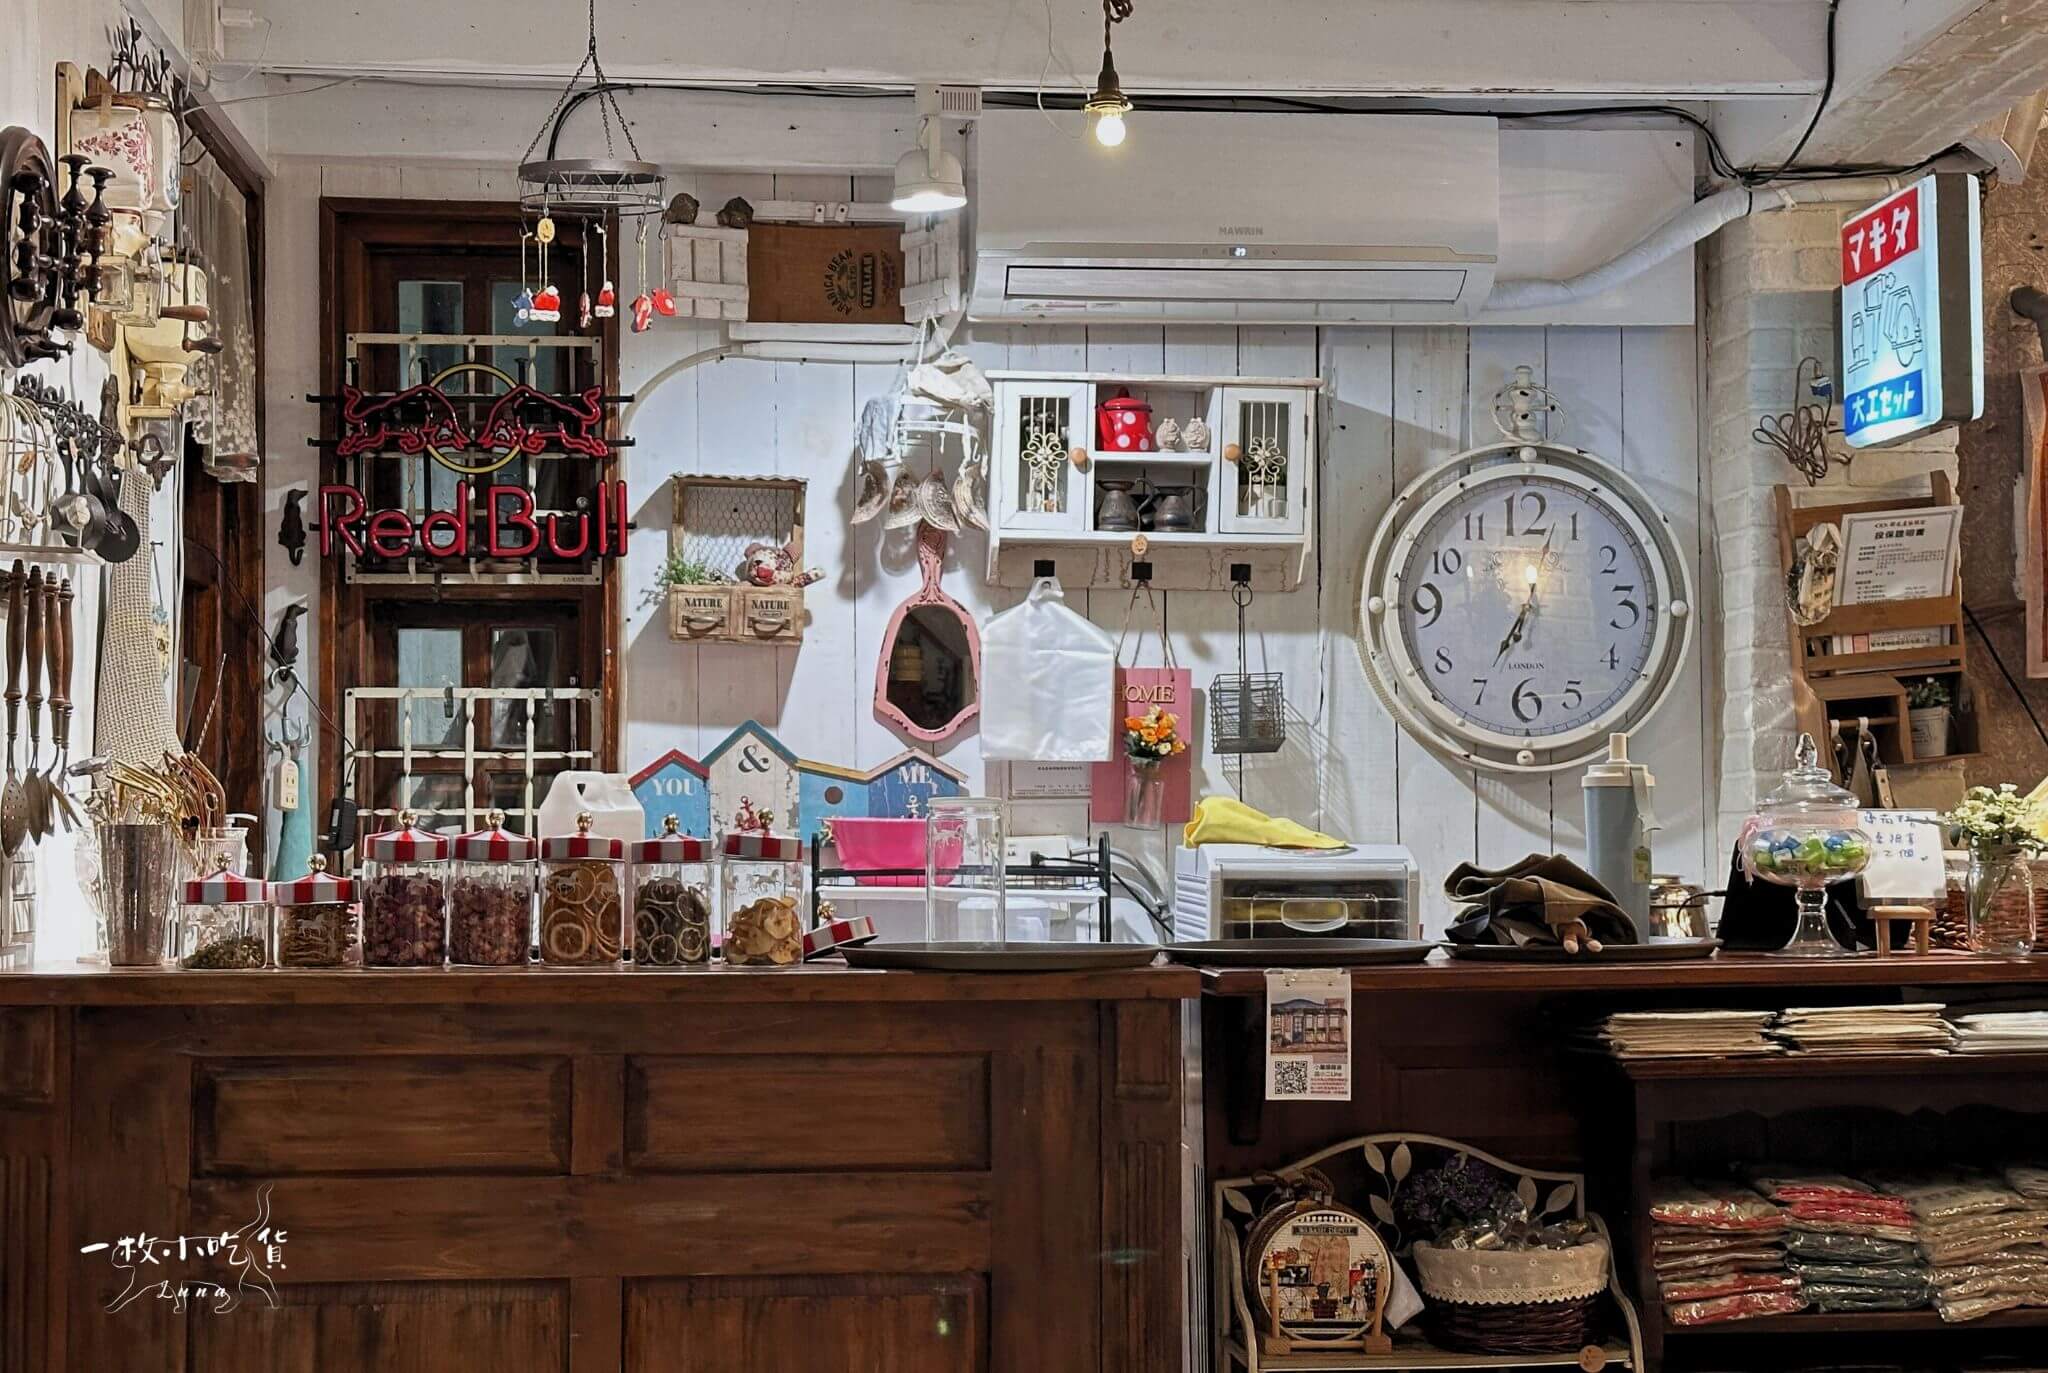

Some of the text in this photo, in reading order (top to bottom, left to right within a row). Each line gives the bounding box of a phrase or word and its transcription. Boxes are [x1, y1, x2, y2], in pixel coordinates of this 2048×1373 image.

[1219, 226, 1263, 236] MAWRIN
[1849, 205, 1911, 273] マキタ
[1852, 380, 1916, 426] 大工セット
[319, 480, 628, 558] Red Bull
[1464, 511, 1485, 541] 11
[1503, 491, 1547, 537] 12
[1570, 511, 1579, 541] 1
[1432, 548, 1462, 575] 10
[1600, 545, 1617, 574] 2
[684, 597, 723, 608] NATURE
[752, 600, 790, 610] NATURE
[1411, 582, 1443, 629] 9
[1610, 584, 1640, 630] 3
[1434, 646, 1453, 675] 8
[1508, 662, 1546, 671] LONDON
[1600, 642, 1620, 671] 4
[1472, 678, 1488, 706] 7
[1511, 677, 1543, 723] 6
[1561, 680, 1582, 710] 5
[738, 744, 770, 774] &
[651, 776, 697, 797] YOU
[899, 765, 933, 785] ME
